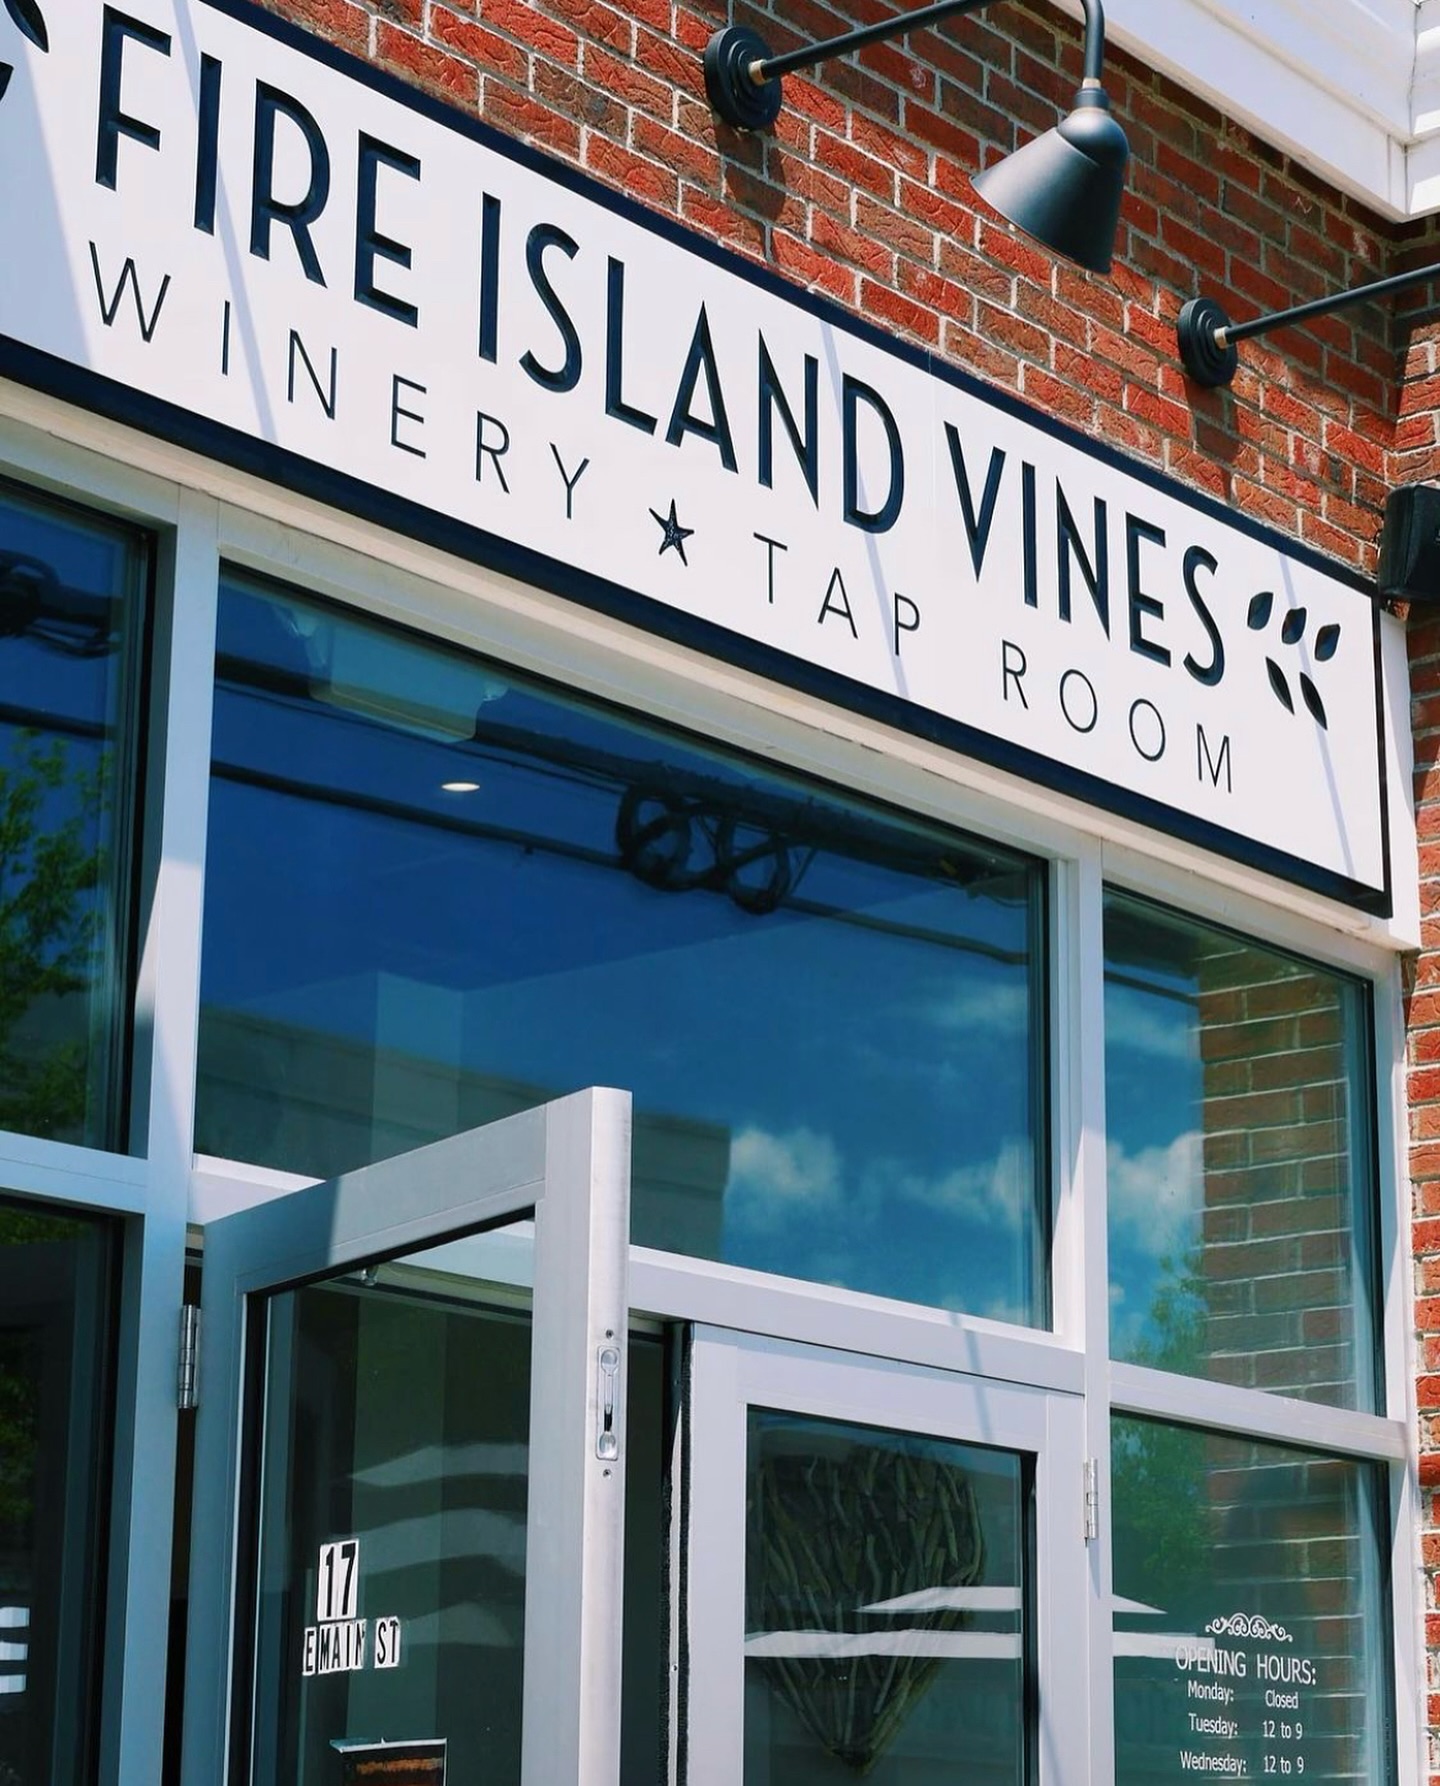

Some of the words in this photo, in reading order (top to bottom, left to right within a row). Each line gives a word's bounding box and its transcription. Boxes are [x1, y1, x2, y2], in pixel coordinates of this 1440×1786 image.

[95, 4, 422, 329] FIRE
[478, 191, 905, 535] ISLAND
[943, 421, 1225, 687] VINES
[88, 240, 590, 520] WINERY
[754, 532, 921, 656] TAP
[1001, 639, 1232, 793] ROOM
[325, 1543, 356, 1618] 17
[377, 1621, 399, 1664] ST
[1175, 1646, 1246, 1677] OPENING
[1256, 1654, 1316, 1685] HOURS:
[1187, 1680, 1234, 1705] Monday:
[1265, 1690, 1298, 1709] Closed
[1188, 1713, 1238, 1739] Tuesday:
[1262, 1720, 1275, 1738] 12
[1280, 1722, 1292, 1739] to
[1295, 1723, 1303, 1740] 9
[1180, 1751, 1247, 1777] Wednesday:
[1264, 1755, 1277, 1773] 12
[1280, 1757, 1292, 1774] to
[1296, 1756, 1304, 1774] 9
